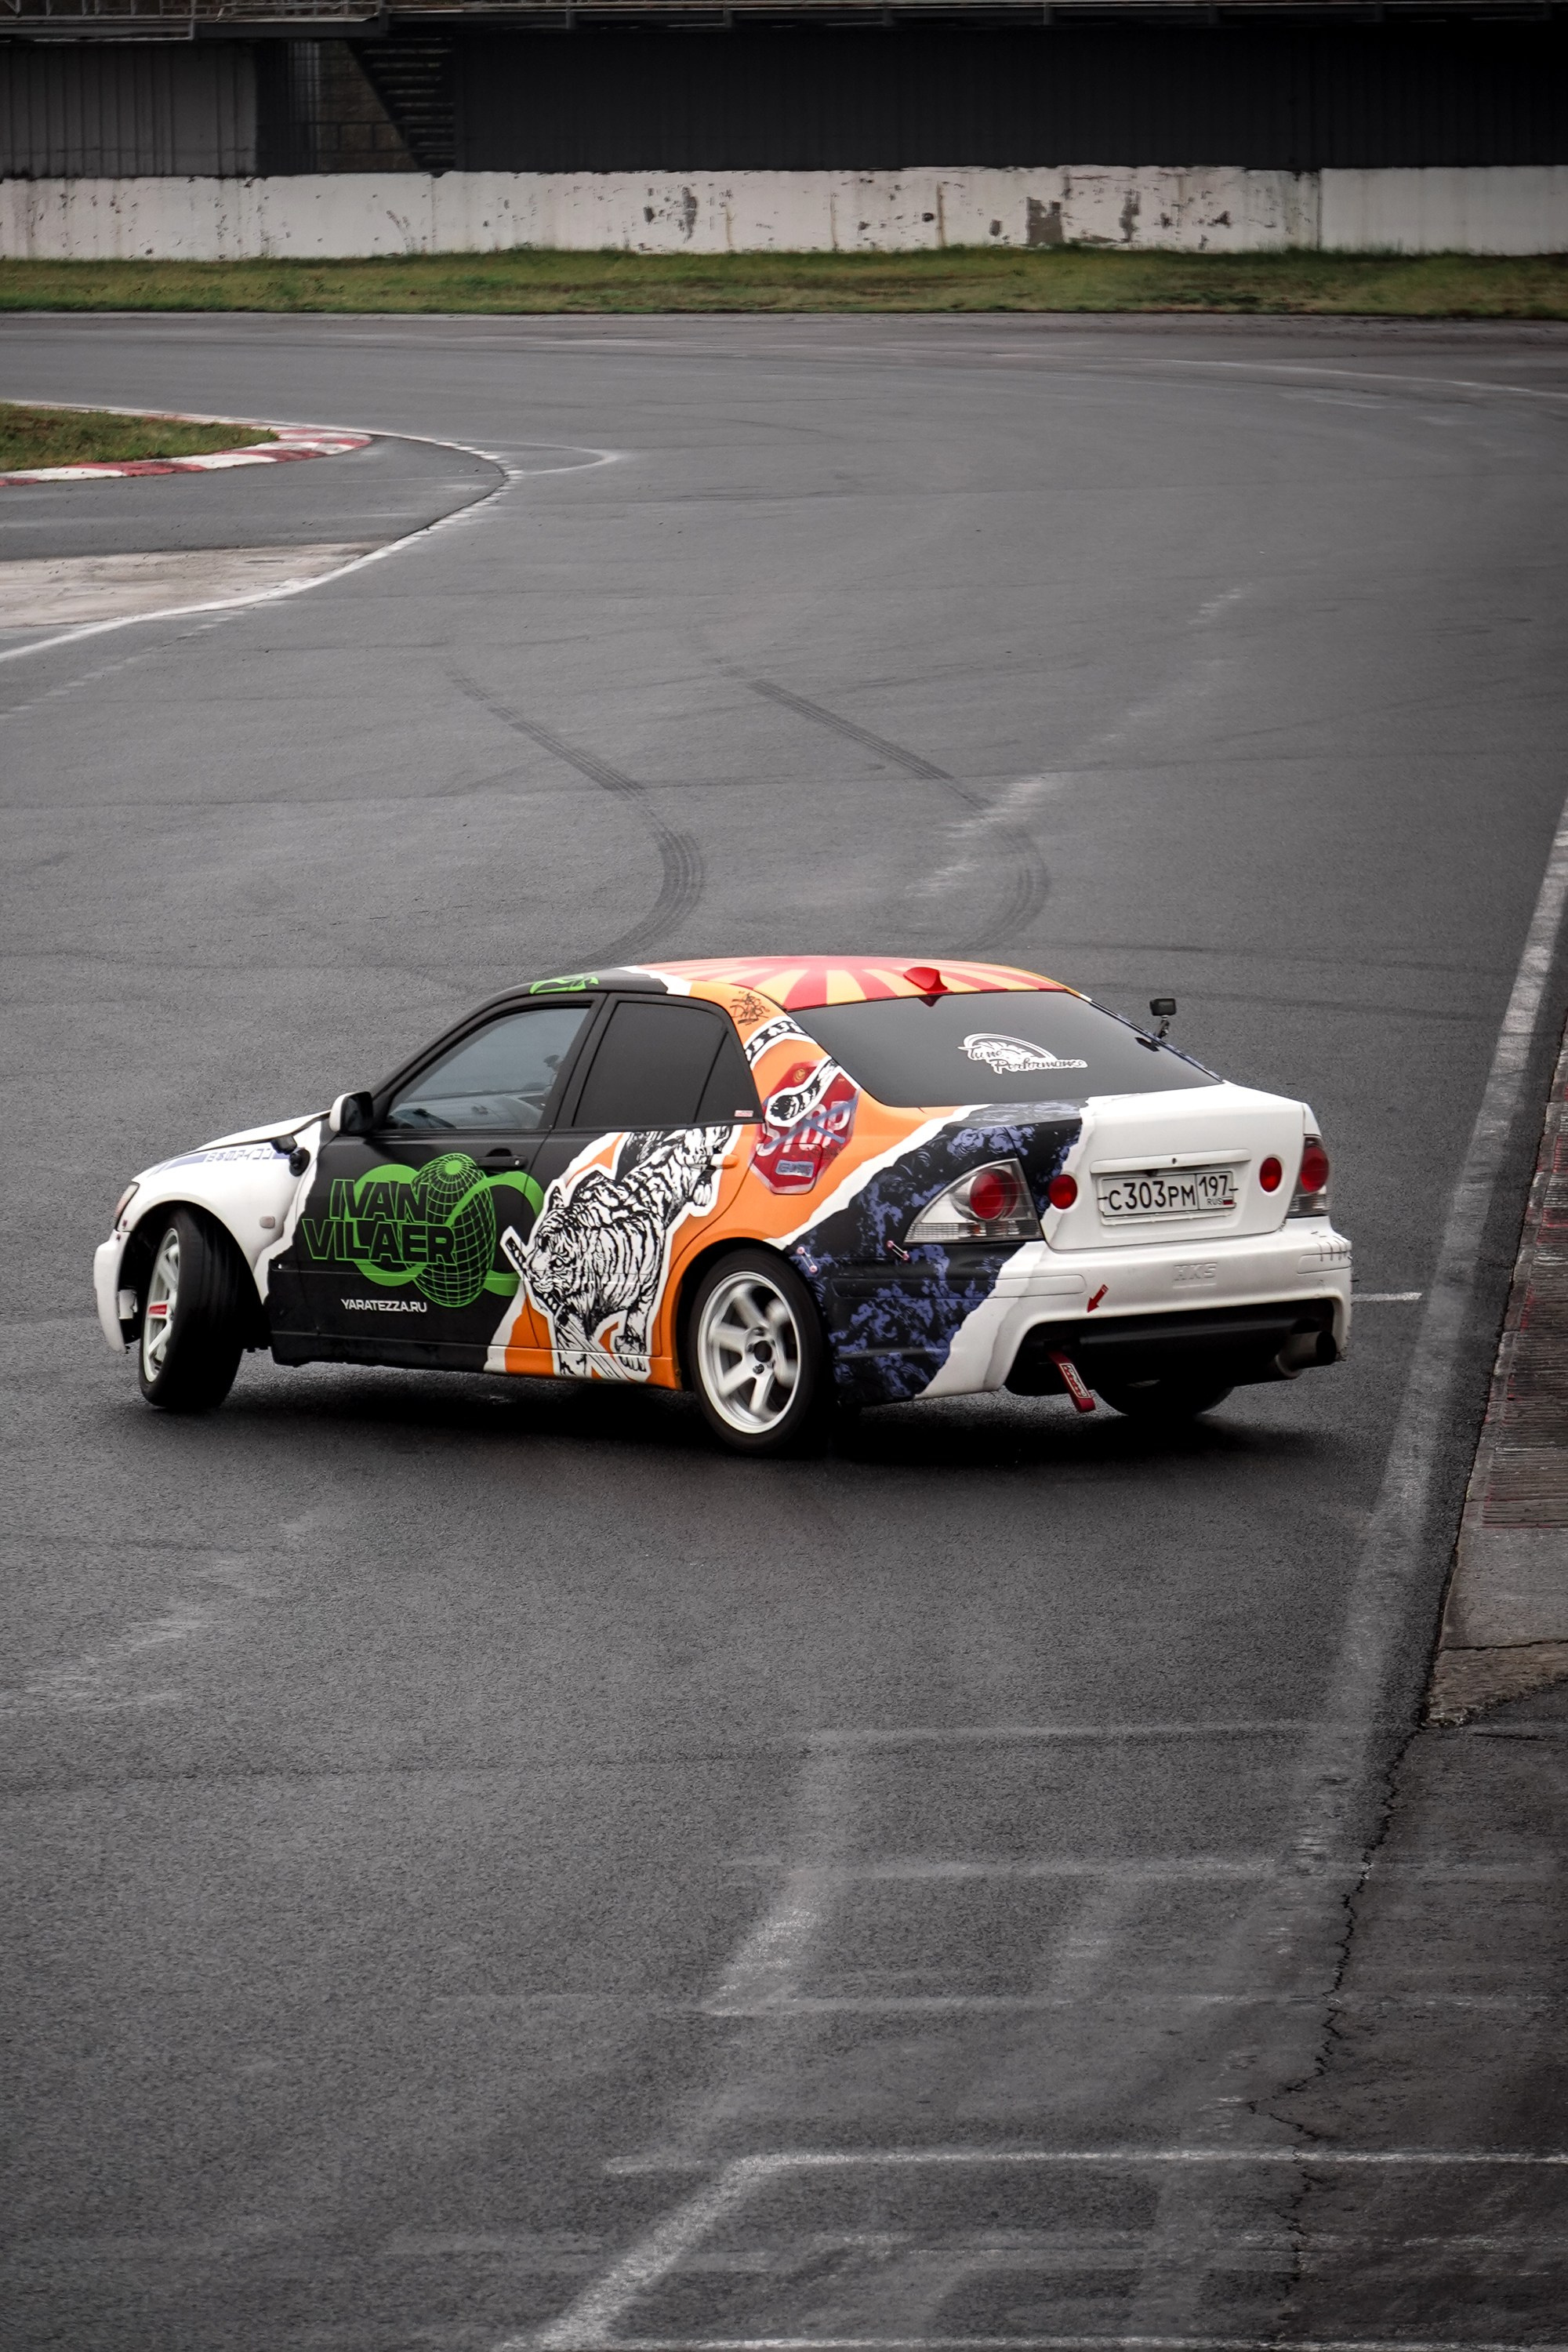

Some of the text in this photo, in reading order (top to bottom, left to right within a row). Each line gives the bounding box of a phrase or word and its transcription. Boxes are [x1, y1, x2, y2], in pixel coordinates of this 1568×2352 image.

[1199, 1175, 1229, 1197] 197
[329, 1178, 430, 1225] IVAN
[1207, 1197, 1223, 1206] RUS
[301, 1218, 457, 1266] VILAER
[340, 1298, 428, 1314] YARATEZZA.RU
